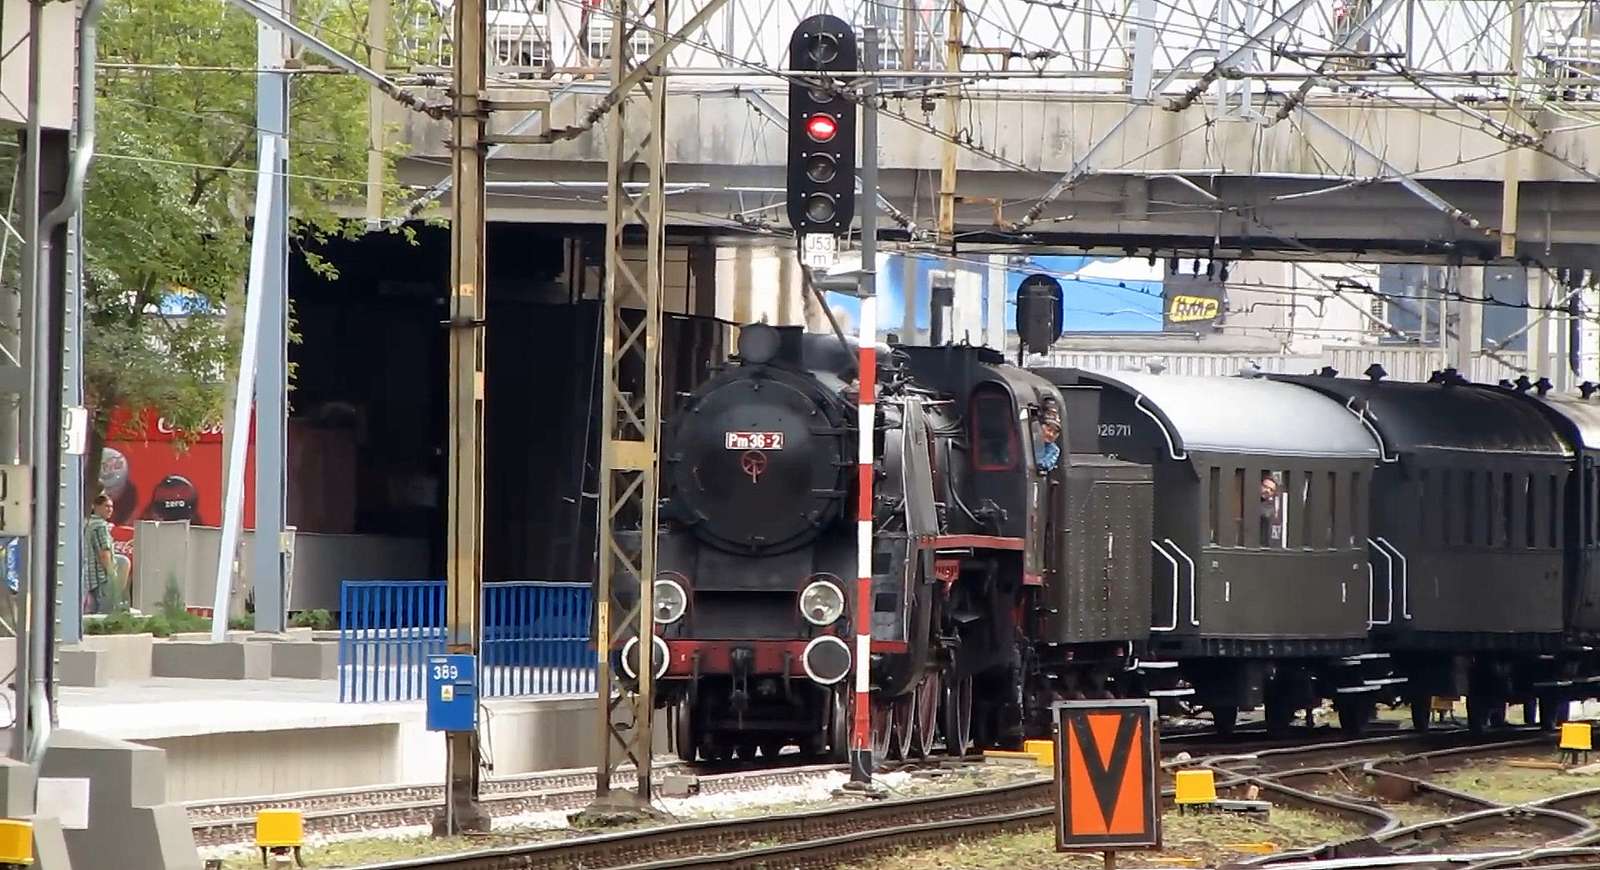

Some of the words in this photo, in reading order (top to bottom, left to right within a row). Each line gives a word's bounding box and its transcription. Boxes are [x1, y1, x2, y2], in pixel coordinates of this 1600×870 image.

[807, 236, 832, 251] J53
[165, 501, 185, 509] zero
[433, 665, 459, 680] 389
